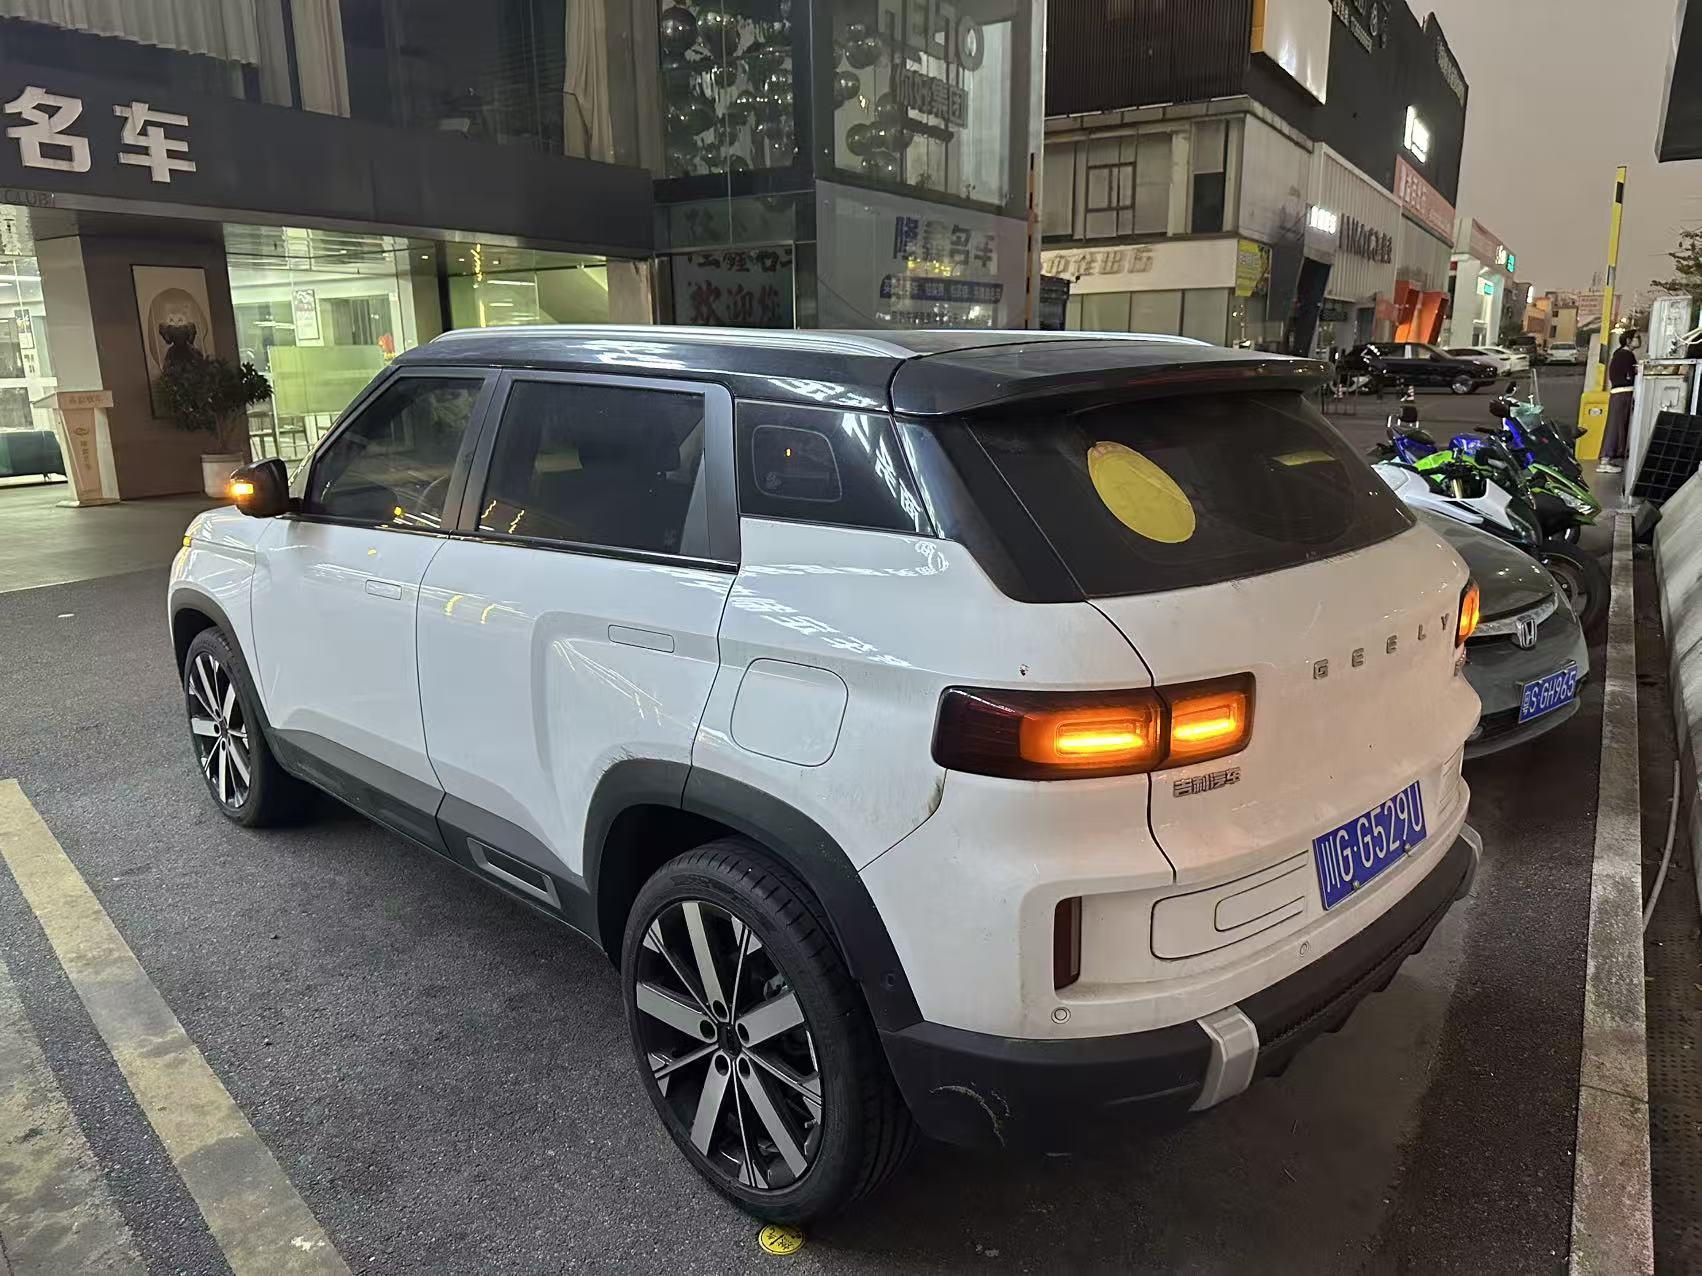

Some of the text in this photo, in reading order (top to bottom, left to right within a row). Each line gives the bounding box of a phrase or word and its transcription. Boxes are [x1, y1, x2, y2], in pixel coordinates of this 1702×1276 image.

[3, 86, 197, 183] 名车
[1312, 612, 1450, 680] GEELY
[1172, 766, 1242, 798] 吉利汽车
[1319, 784, 1424, 893] 川G·G529U
